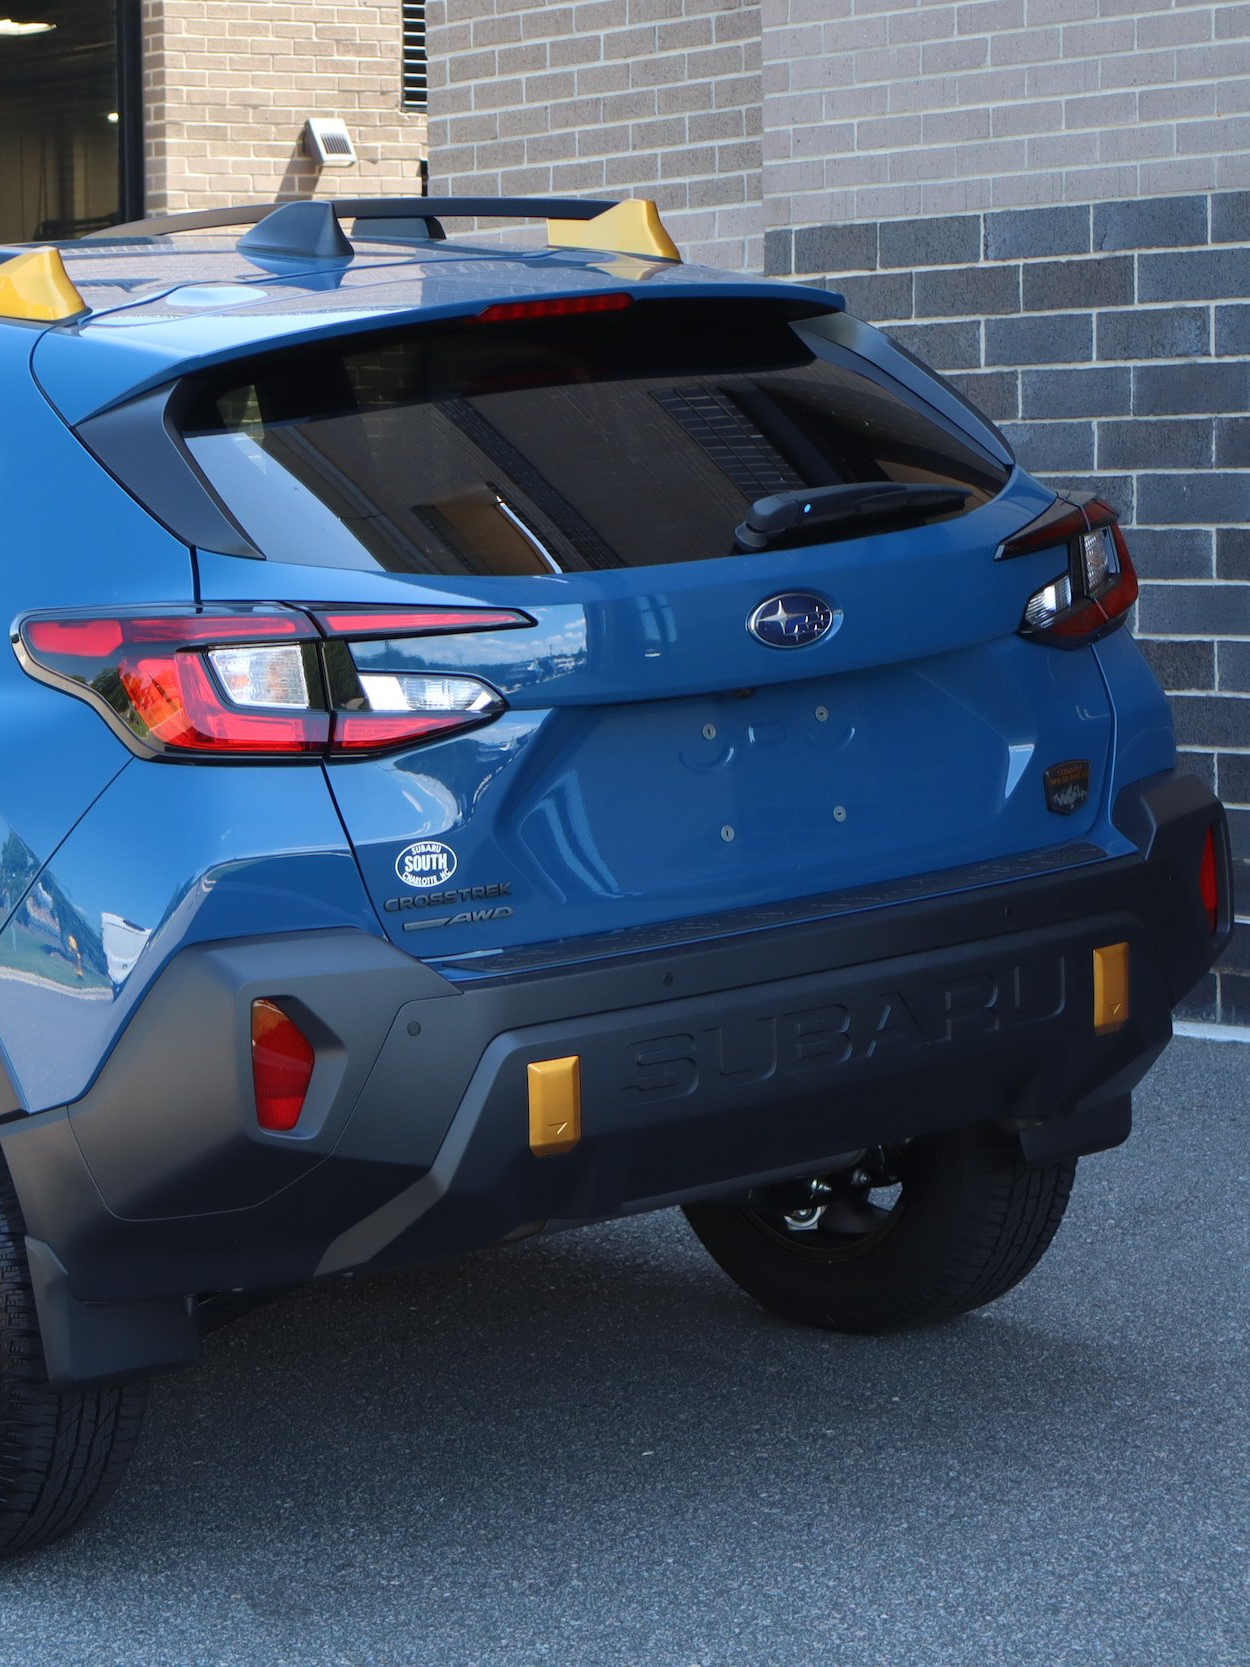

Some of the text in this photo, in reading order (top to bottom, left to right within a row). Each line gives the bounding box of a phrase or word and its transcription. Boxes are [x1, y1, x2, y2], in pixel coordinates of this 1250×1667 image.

[411, 844, 442, 855] SUBARU
[404, 853, 448, 872] SOUTH
[439, 868, 451, 880] NC
[383, 882, 512, 912] CROSSTREK
[445, 906, 514, 926] AWD
[622, 955, 1068, 1106] SUBARU
